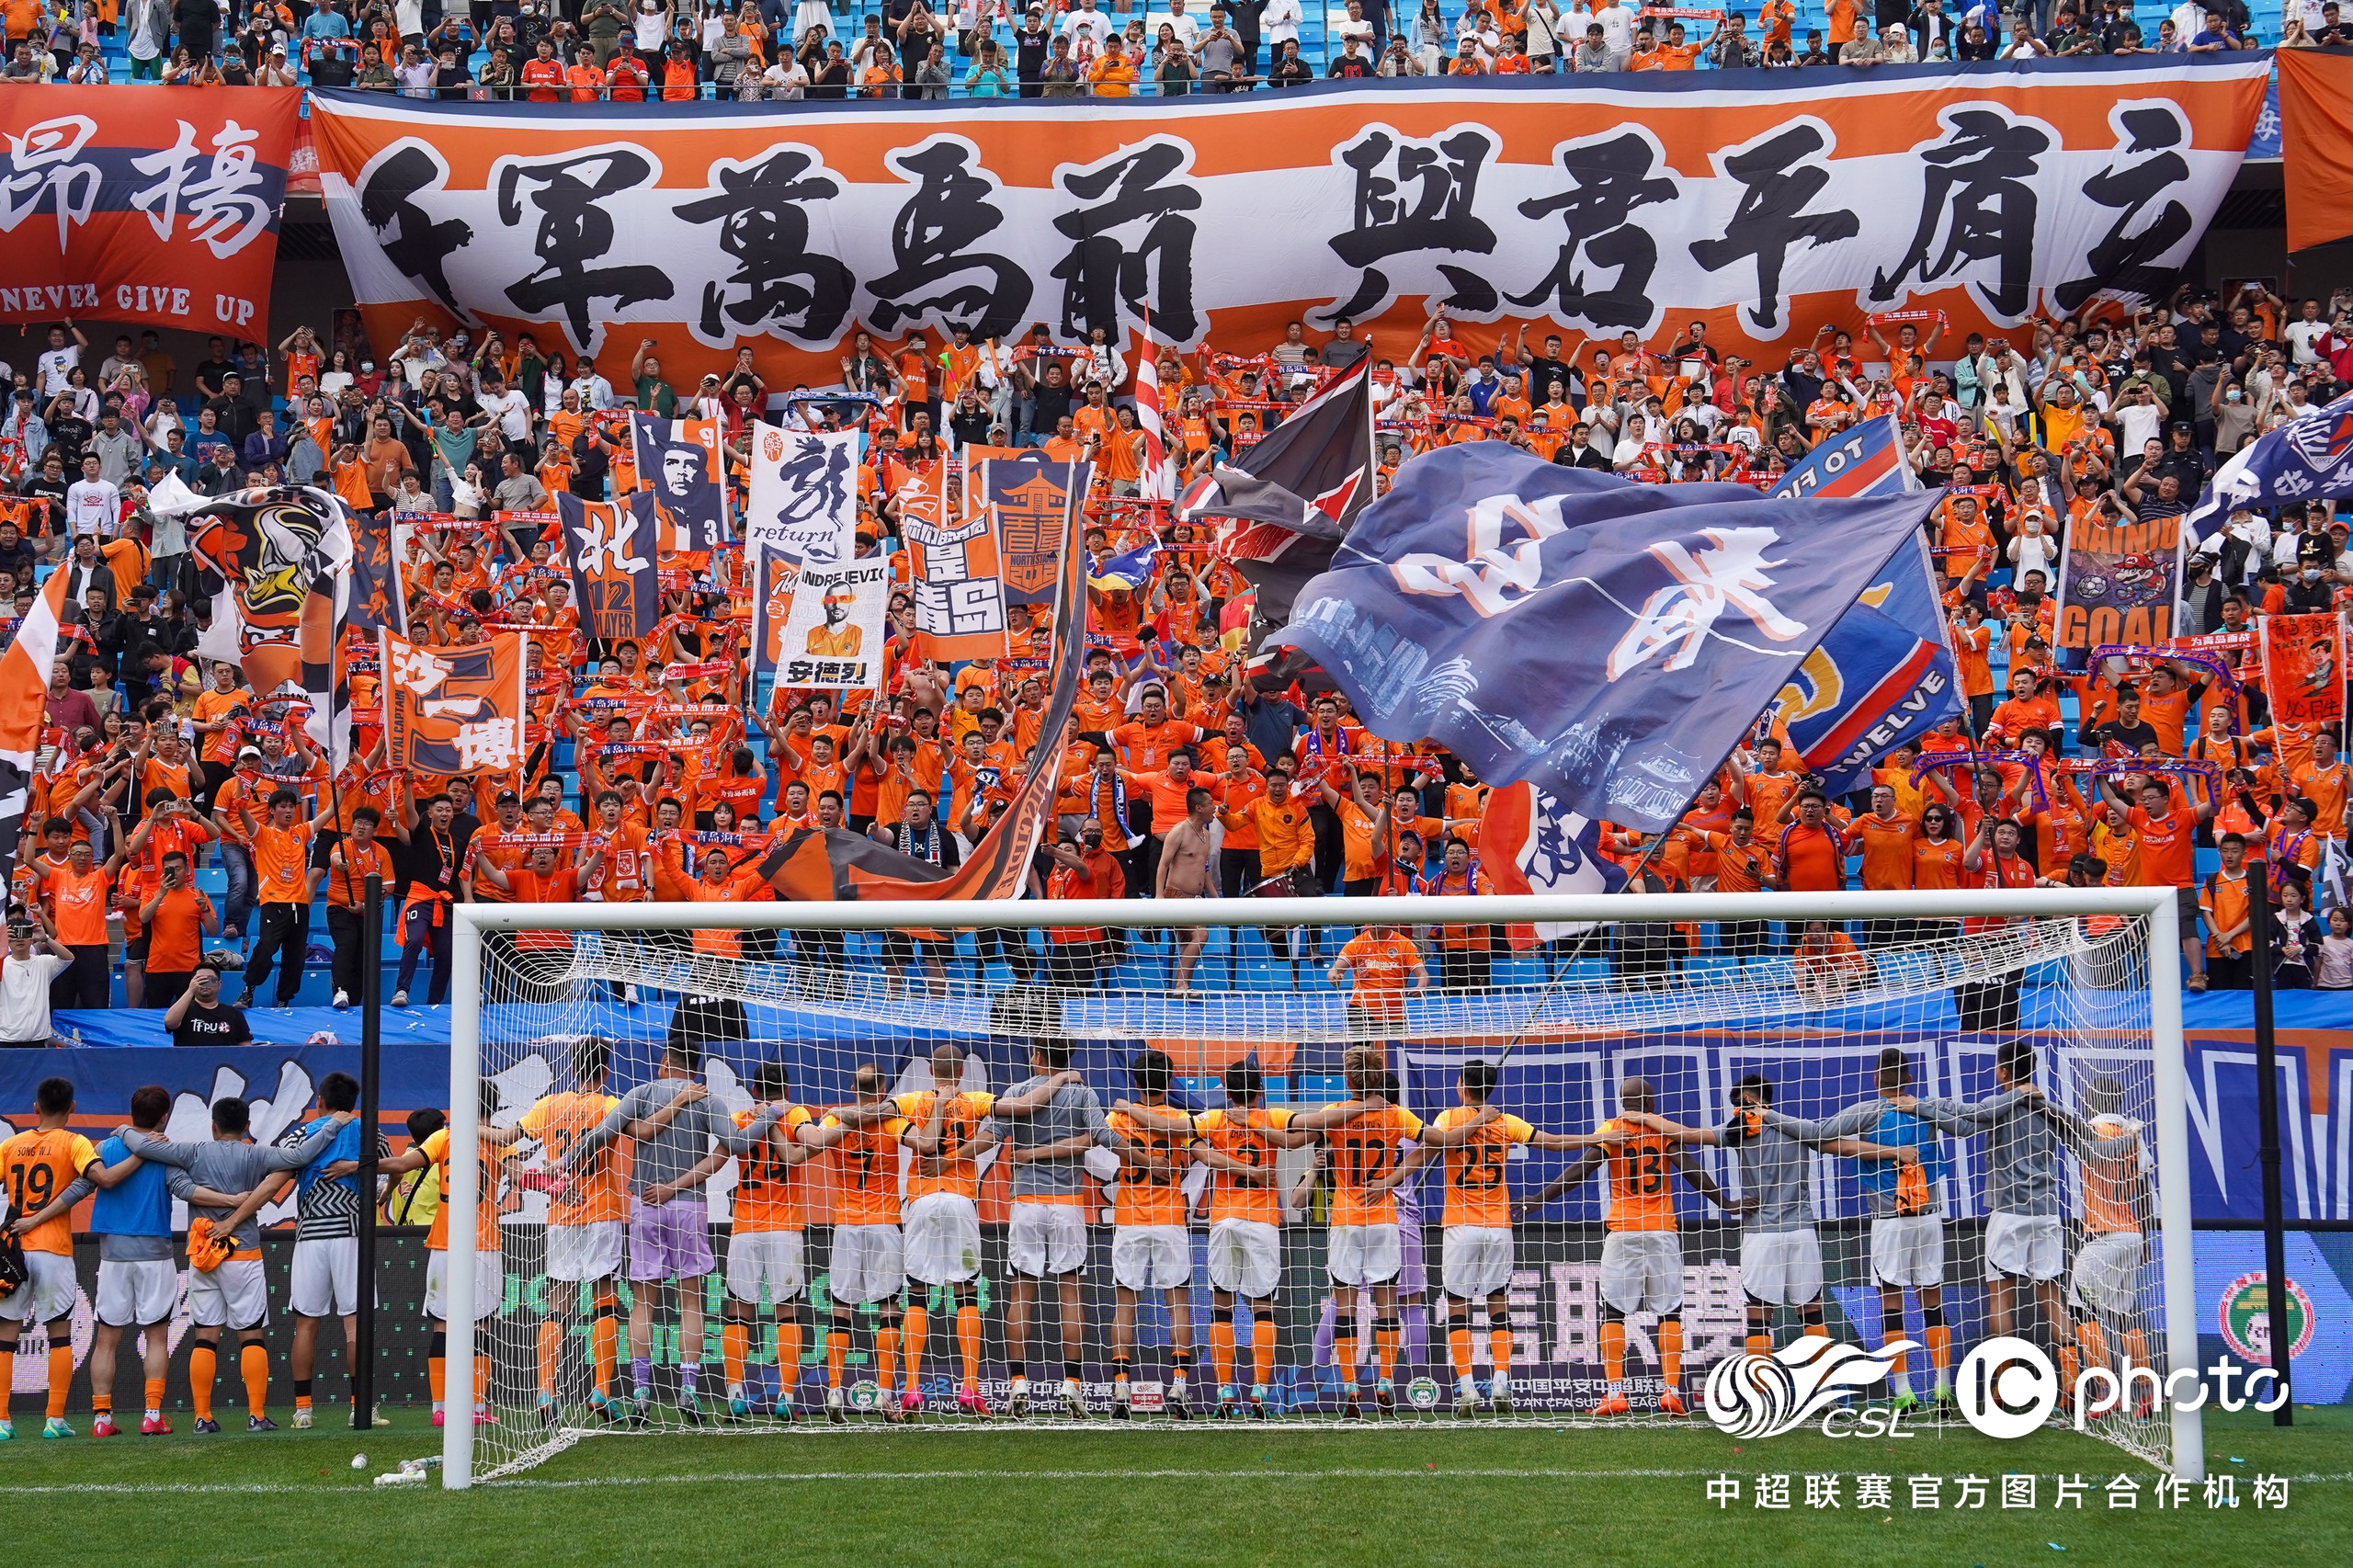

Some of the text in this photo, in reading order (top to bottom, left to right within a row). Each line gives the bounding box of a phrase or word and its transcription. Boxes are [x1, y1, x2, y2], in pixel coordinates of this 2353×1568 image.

[0, 283, 255, 325] NEVER GIVE UP
[699, 427, 715, 449] 9
[571, 500, 651, 576] 北
[702, 520, 718, 546] 3
[753, 523, 835, 544] return
[1010, 554, 1035, 566] NORTH
[1009, 564, 1057, 590] 2012
[588, 579, 633, 611] 12
[594, 611, 633, 639] PLAYER
[2191, 635, 2251, 646] 为青岛而战
[786, 660, 869, 686] 安德烈
[392, 688, 405, 767] LOYAL CAPTAIN
[1824, 670, 1948, 774] TWELVE
[498, 833, 565, 843] 为青岛而战
[697, 830, 743, 845] 青岛海牛
[406, 909, 418, 920] 10
[17, 1144, 36, 1156] SONG
[1346, 1138, 1386, 1187] 12
[741, 1147, 788, 1190] 24
[849, 1148, 875, 1189] 7
[1455, 1144, 1505, 1190] 25
[1623, 1145, 1663, 1195] 13
[11, 1162, 55, 1211] 19
